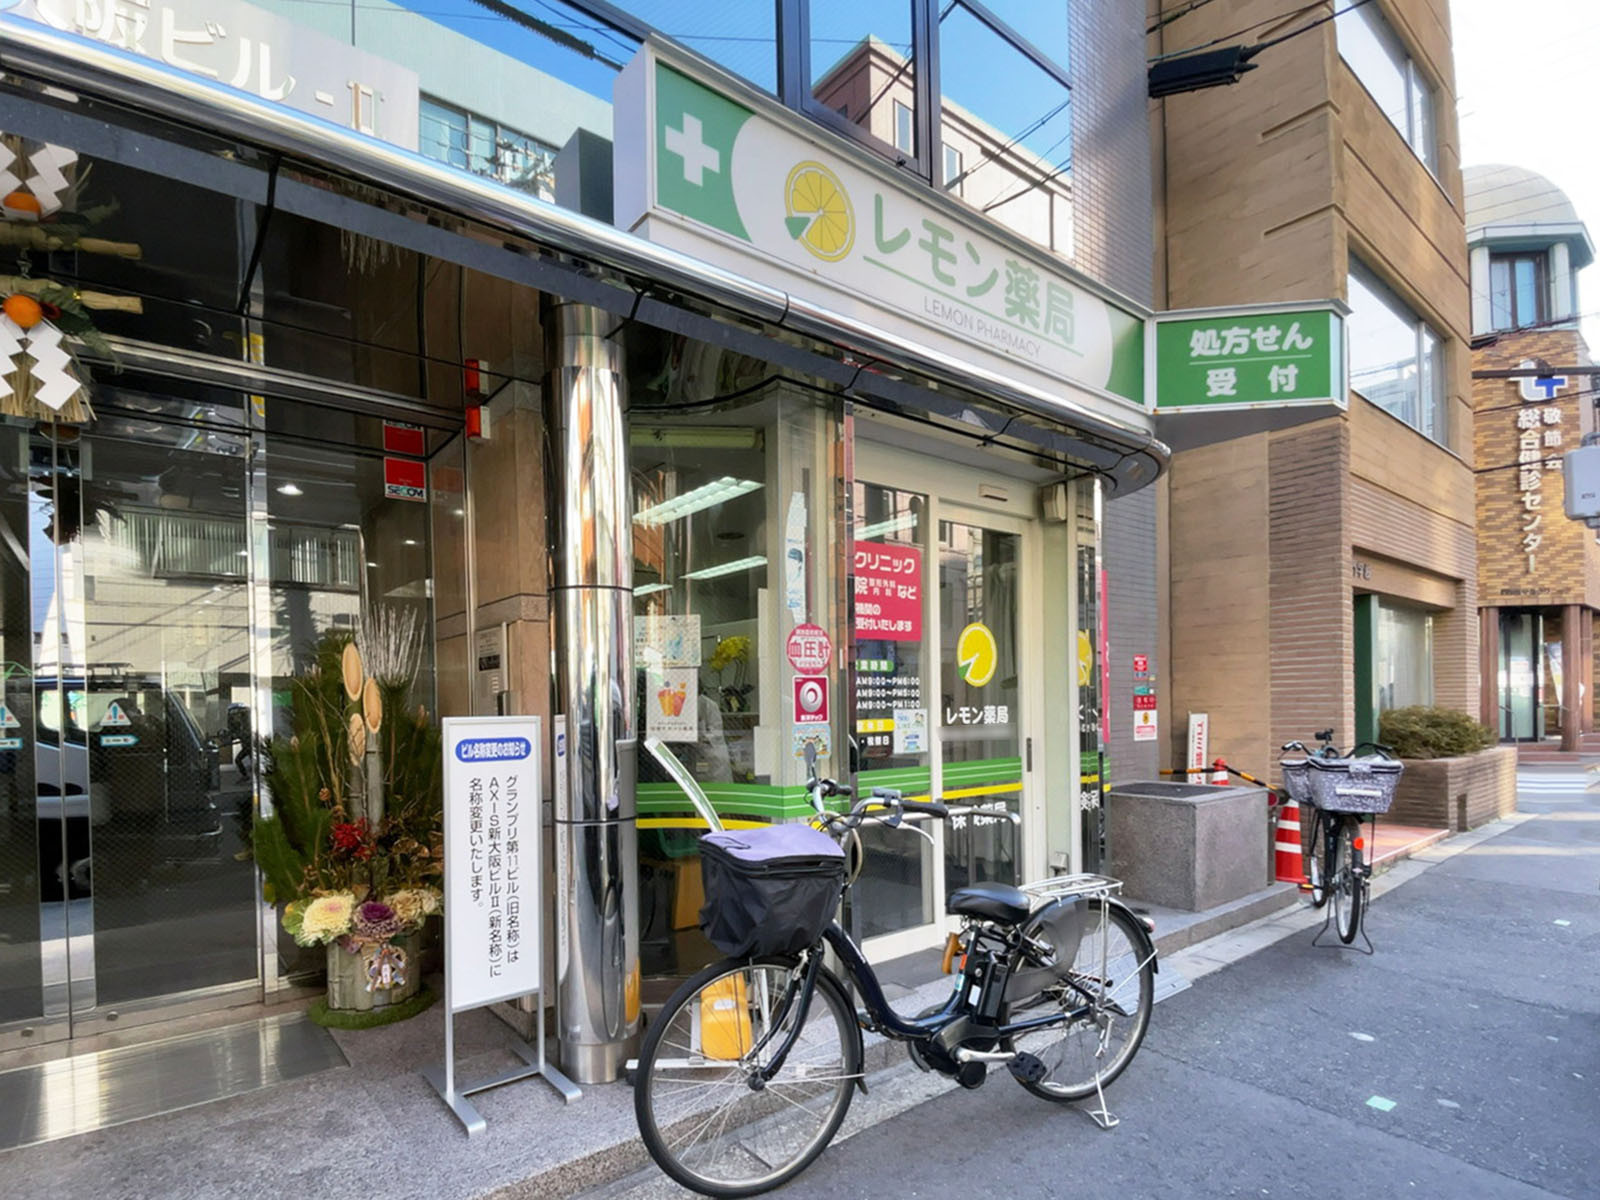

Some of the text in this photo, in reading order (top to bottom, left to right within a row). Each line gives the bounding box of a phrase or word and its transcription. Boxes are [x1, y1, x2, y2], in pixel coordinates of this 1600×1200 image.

[874, 193, 1075, 345] レモン薬局
[924, 295, 1041, 357] LEMON PHARMACY
[1190, 322, 1314, 357] 処方せん
[1517, 408, 1542, 574] 総合健診センター
[855, 551, 915, 574] クリニック
[897, 584, 917, 600] など
[790, 640, 830, 659] 血圧計
[946, 705, 1009, 724] レモン薬局
[469, 778, 484, 907] 名称変更いたします。
